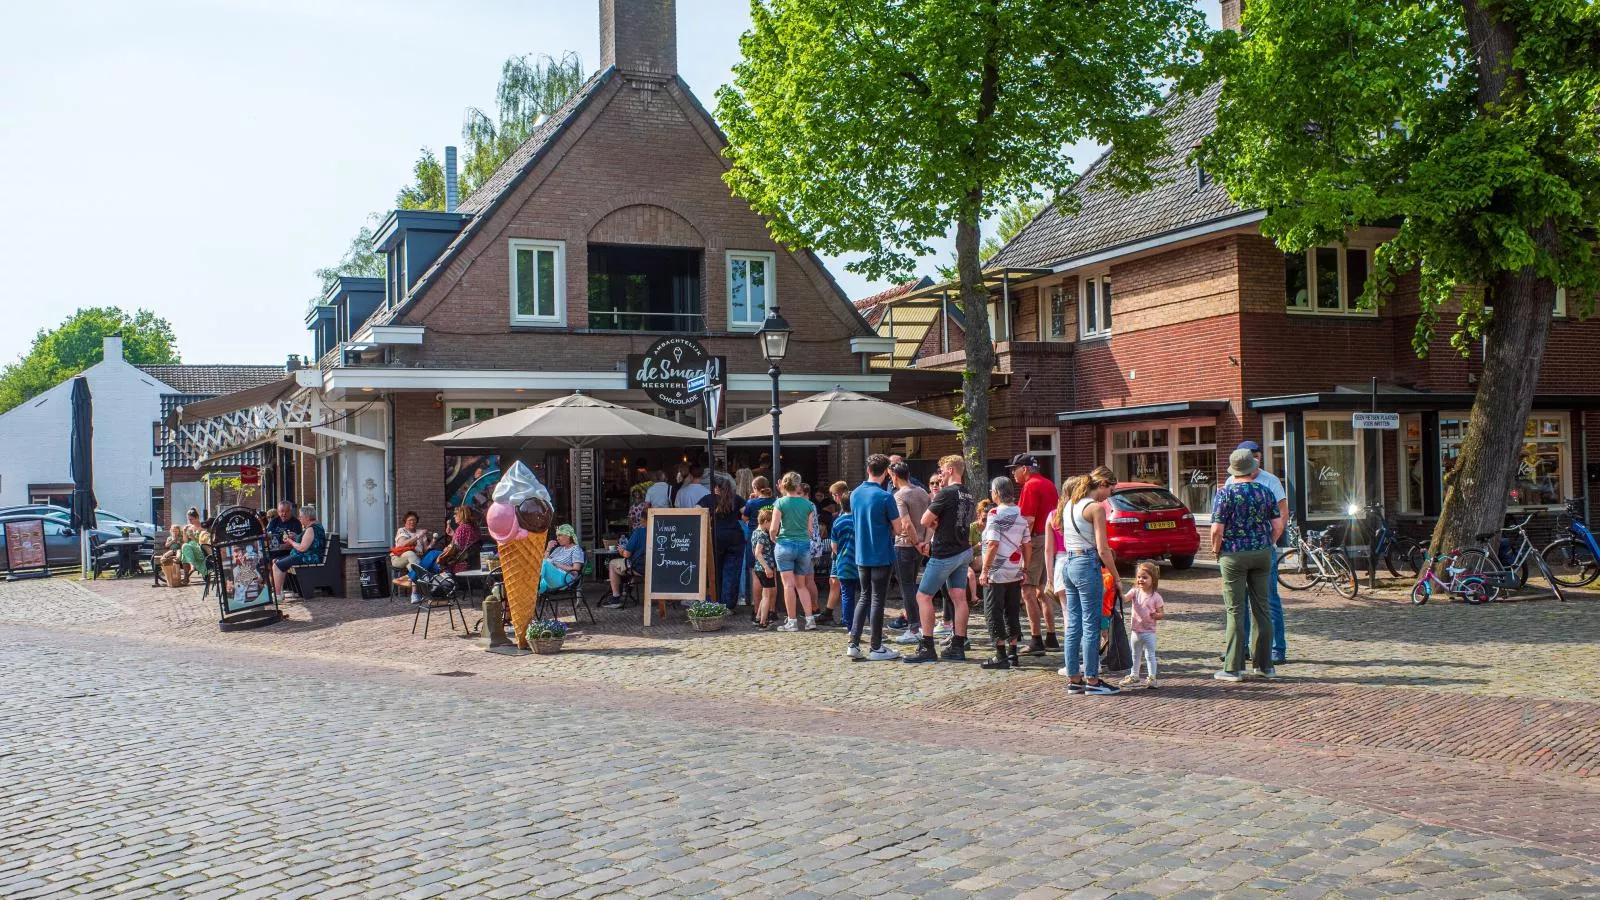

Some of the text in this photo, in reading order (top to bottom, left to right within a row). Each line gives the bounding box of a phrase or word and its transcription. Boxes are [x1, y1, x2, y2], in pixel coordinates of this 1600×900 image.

[654, 338, 702, 357] AMBACHTELIJK
[636, 357, 659, 381] de
[659, 393, 699, 405] CHOCOLADE
